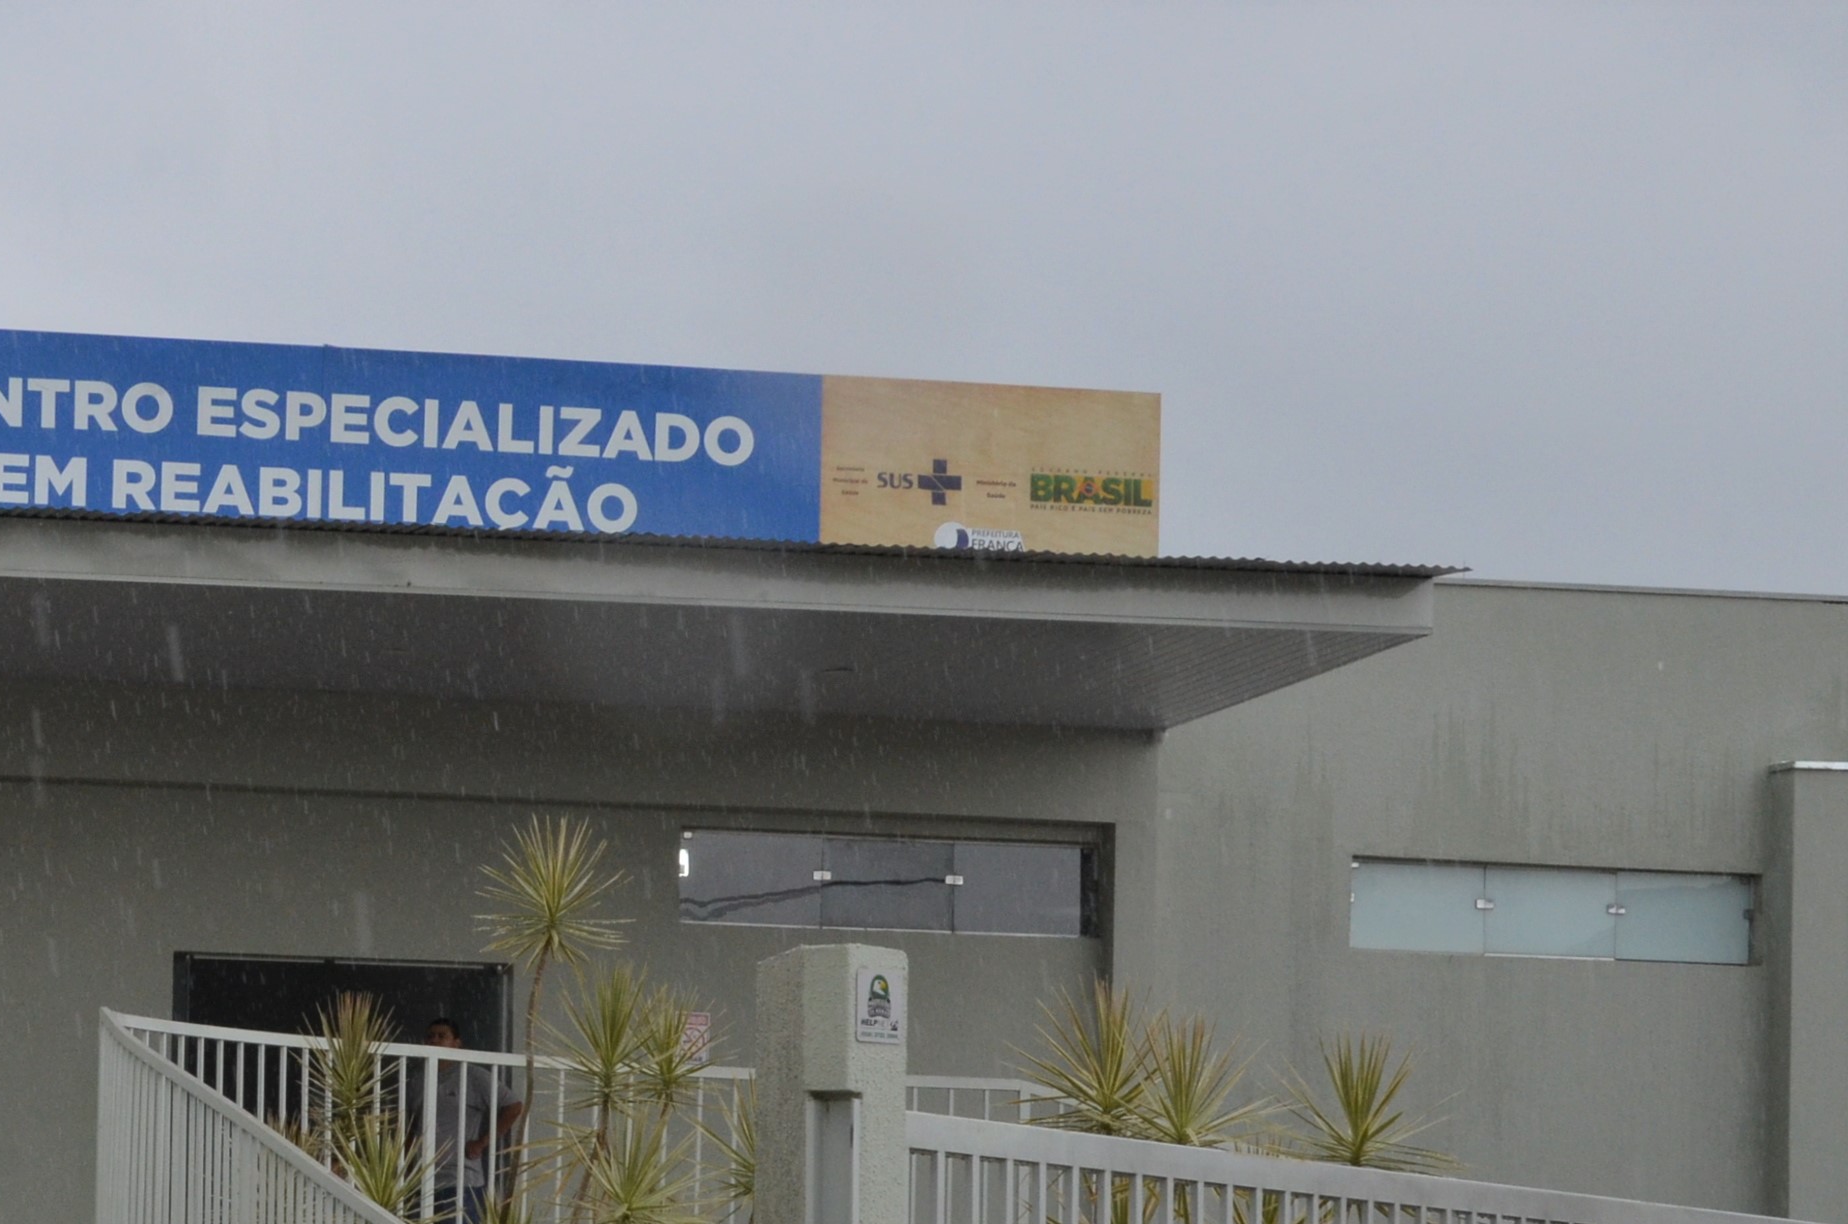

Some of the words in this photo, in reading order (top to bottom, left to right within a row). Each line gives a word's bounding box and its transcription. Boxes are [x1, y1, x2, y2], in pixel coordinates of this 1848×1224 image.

[196, 385, 756, 467] ESPECIALIZADO
[877, 471, 914, 490] SUS
[1029, 473, 1152, 507] BRASIL
[112, 458, 639, 535] REABILITAÇÃO
[971, 528, 1020, 539] PREFEITURA
[971, 538, 1025, 552] FRANCA
